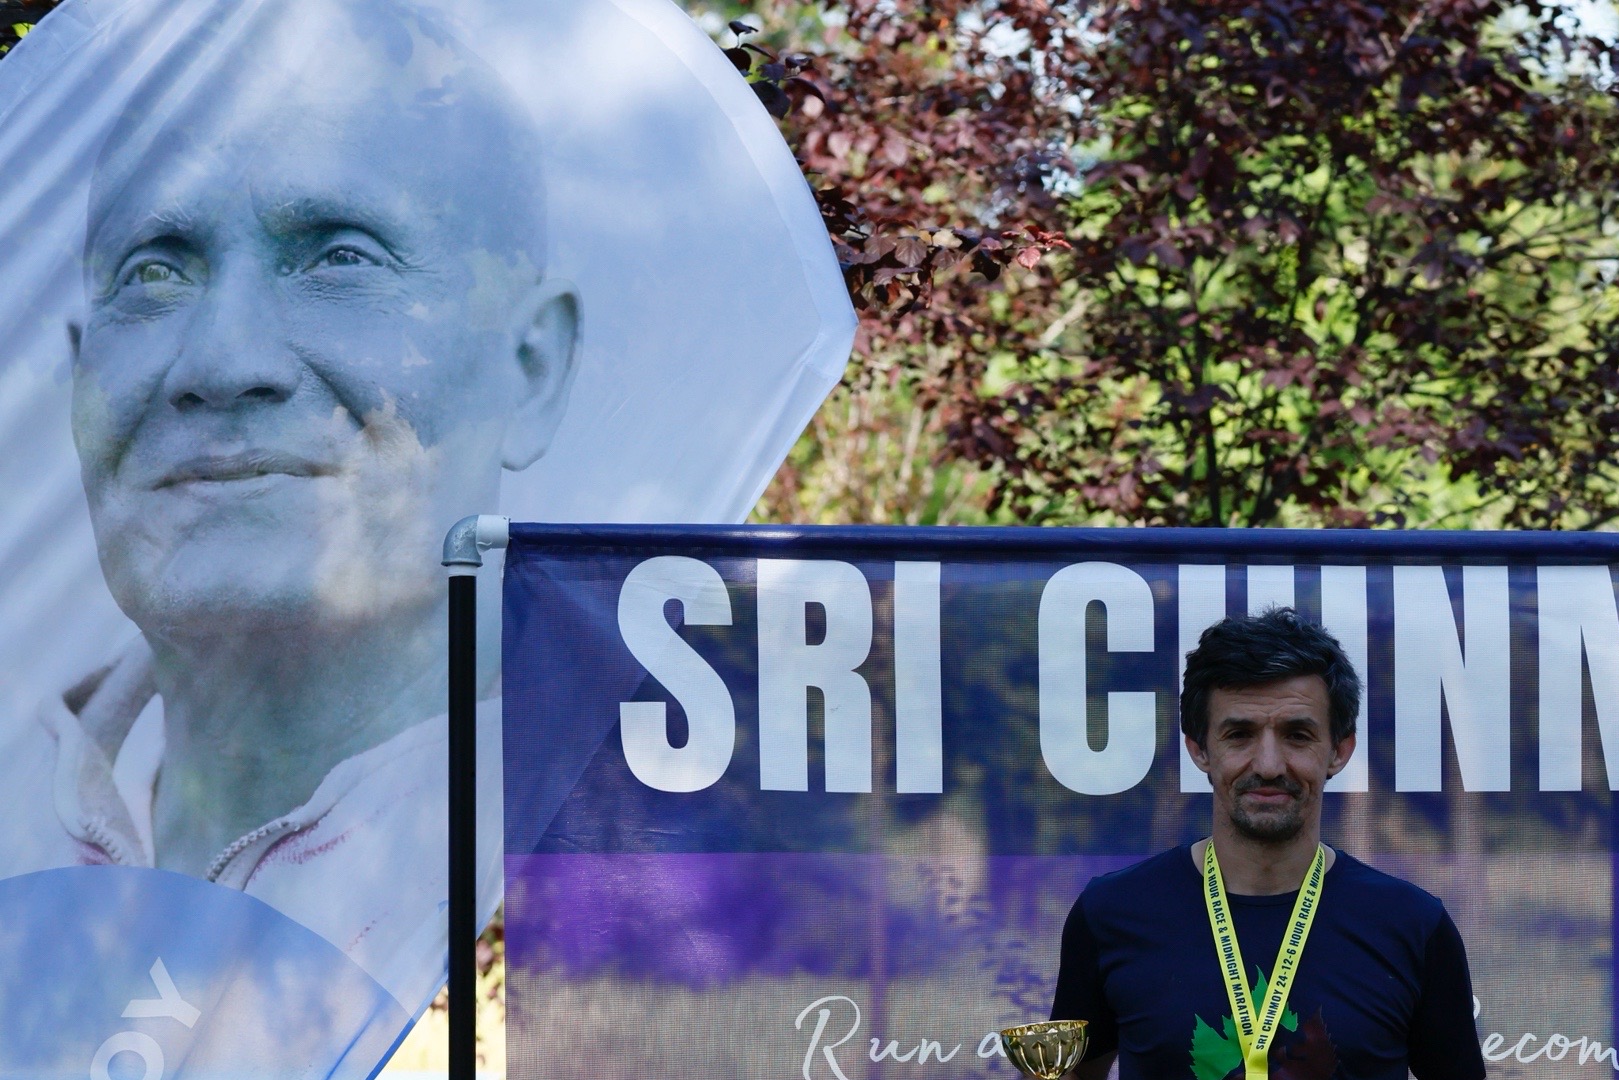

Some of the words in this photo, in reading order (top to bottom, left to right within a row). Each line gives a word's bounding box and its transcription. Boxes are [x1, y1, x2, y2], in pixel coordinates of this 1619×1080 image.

[617, 555, 943, 794] SRI
[1208, 874, 1220, 899] HOUR
[1306, 889, 1316, 898] &
[1212, 900, 1226, 925] RACE
[1298, 896, 1315, 920] RACE
[1290, 920, 1306, 947] HOUR
[1220, 935, 1240, 982] MIDNIGHT
[1276, 948, 1297, 990] 24-12-6
[1232, 983, 1254, 1037] MARATHON
[1261, 988, 1284, 1034] CHINMOY
[1256, 1034, 1269, 1050] SRI
